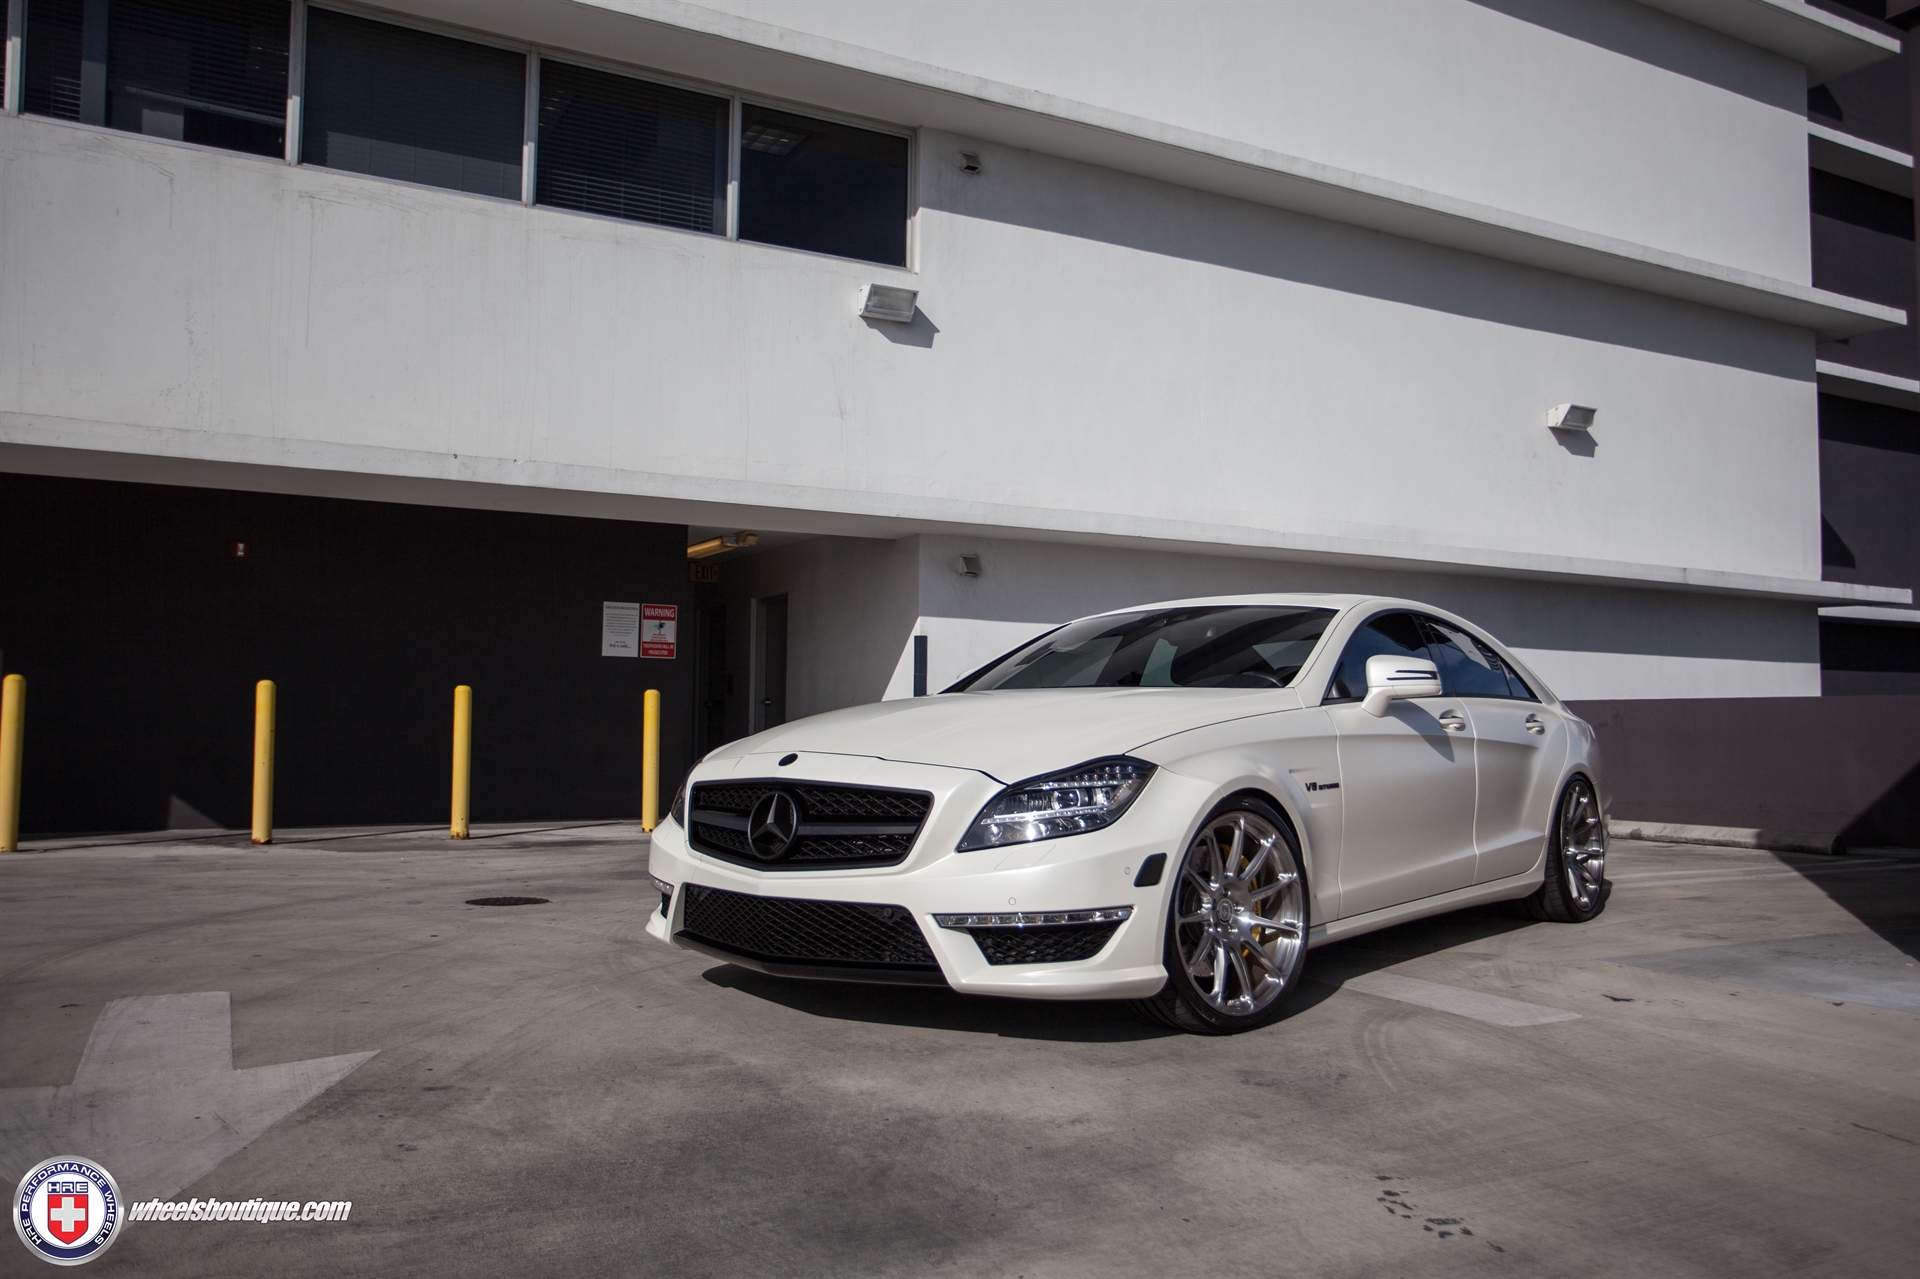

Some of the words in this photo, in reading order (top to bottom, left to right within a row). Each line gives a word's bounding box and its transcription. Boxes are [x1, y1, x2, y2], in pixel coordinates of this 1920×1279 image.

[695, 564, 714, 581] EXIT
[644, 607, 675, 618] WARNING
[1304, 781, 1317, 792] V8
